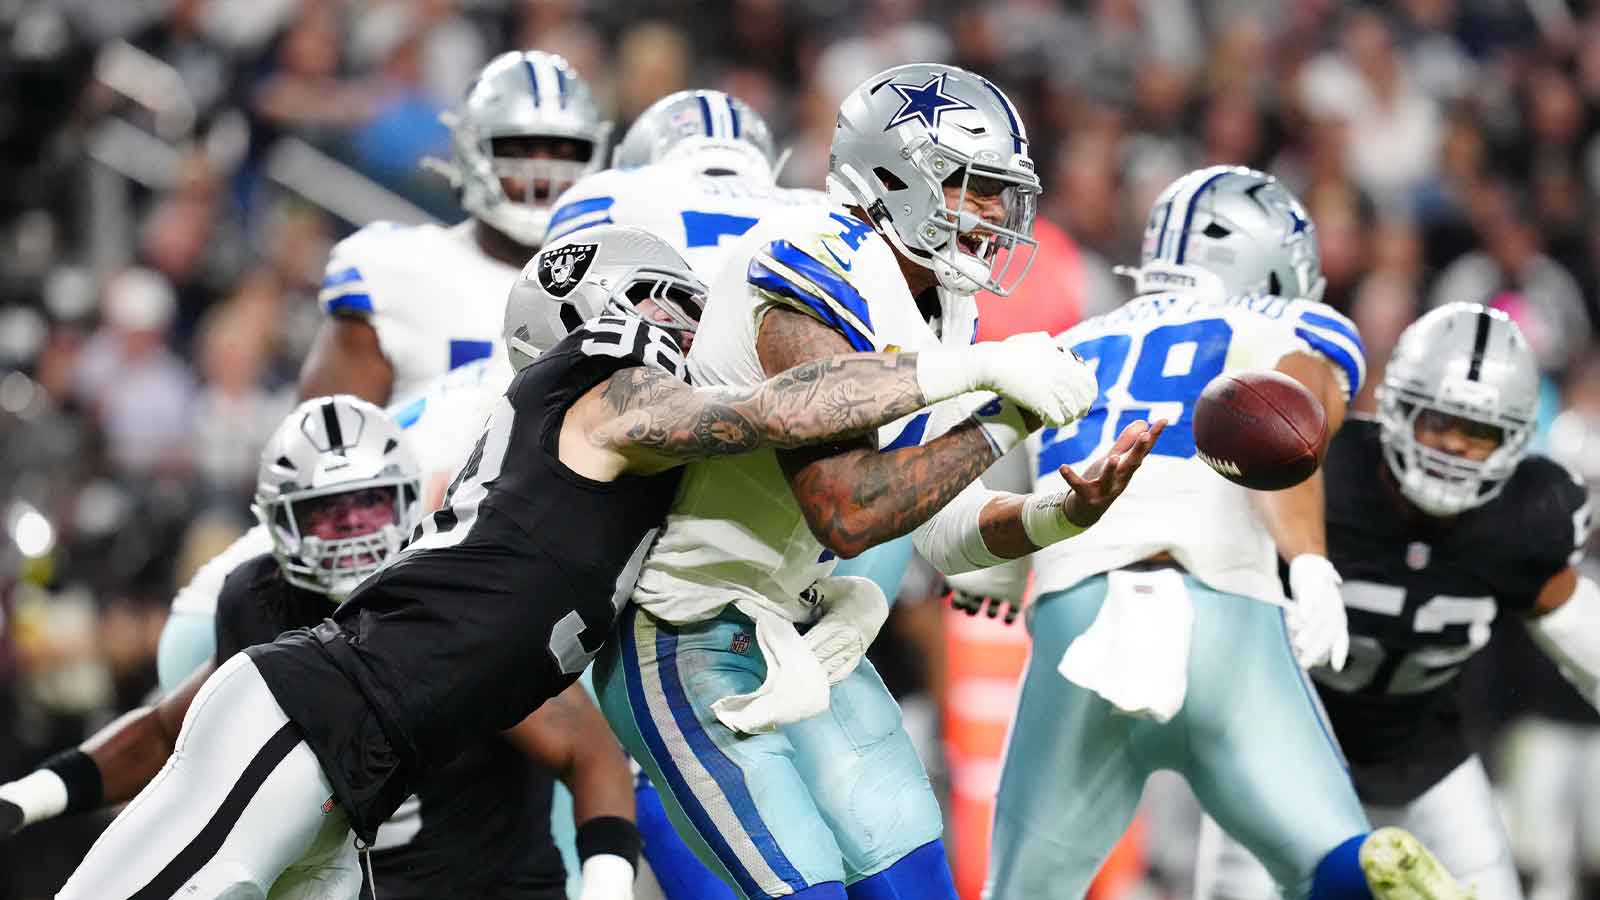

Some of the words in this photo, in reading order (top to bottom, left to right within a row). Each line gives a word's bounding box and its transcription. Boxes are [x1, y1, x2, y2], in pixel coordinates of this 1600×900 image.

[544, 245, 592, 259] RAIDERS
[828, 212, 873, 252] 4
[580, 316, 693, 386] 98
